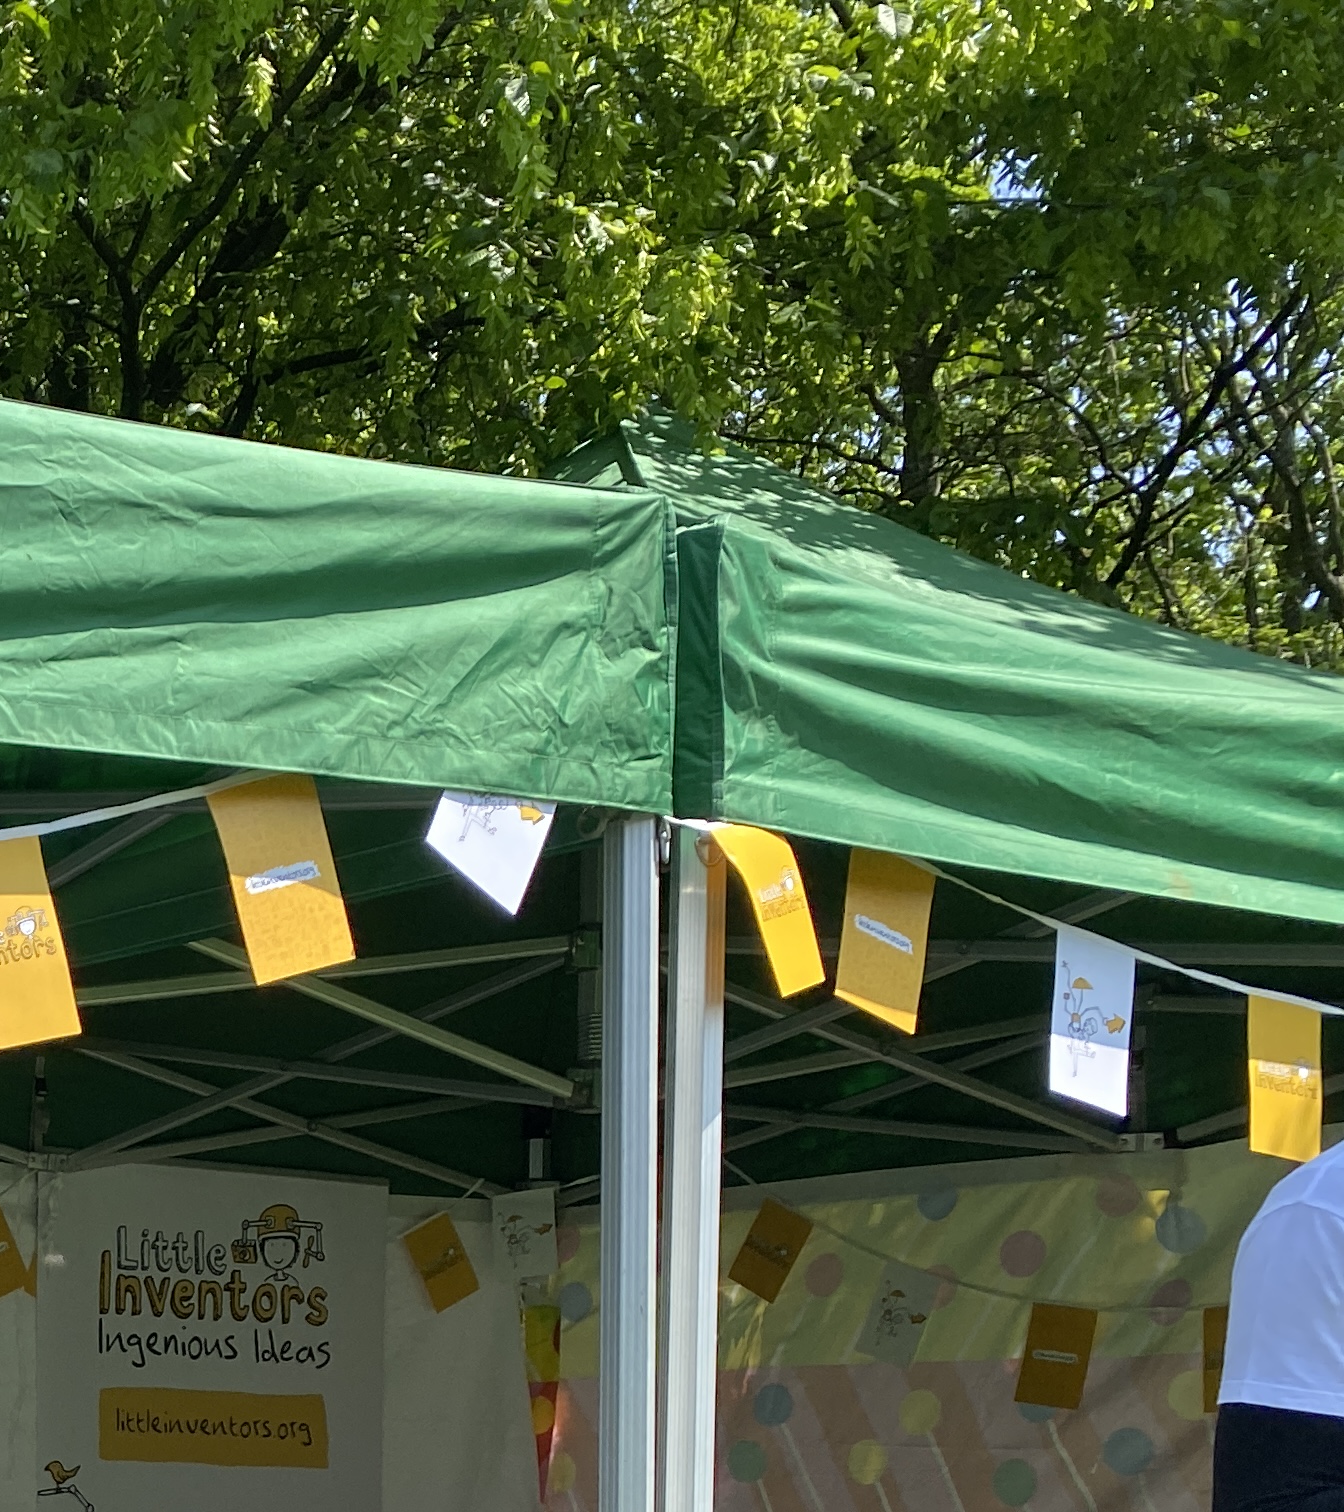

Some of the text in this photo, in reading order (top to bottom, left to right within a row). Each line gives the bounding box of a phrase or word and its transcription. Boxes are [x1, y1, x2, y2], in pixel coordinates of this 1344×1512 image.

[117, 1225, 227, 1276] Little
[99, 1249, 329, 1327] Inventors
[98, 1318, 331, 1369] Ingenious Ideas
[116, 1408, 313, 1446] littleinventors.org
